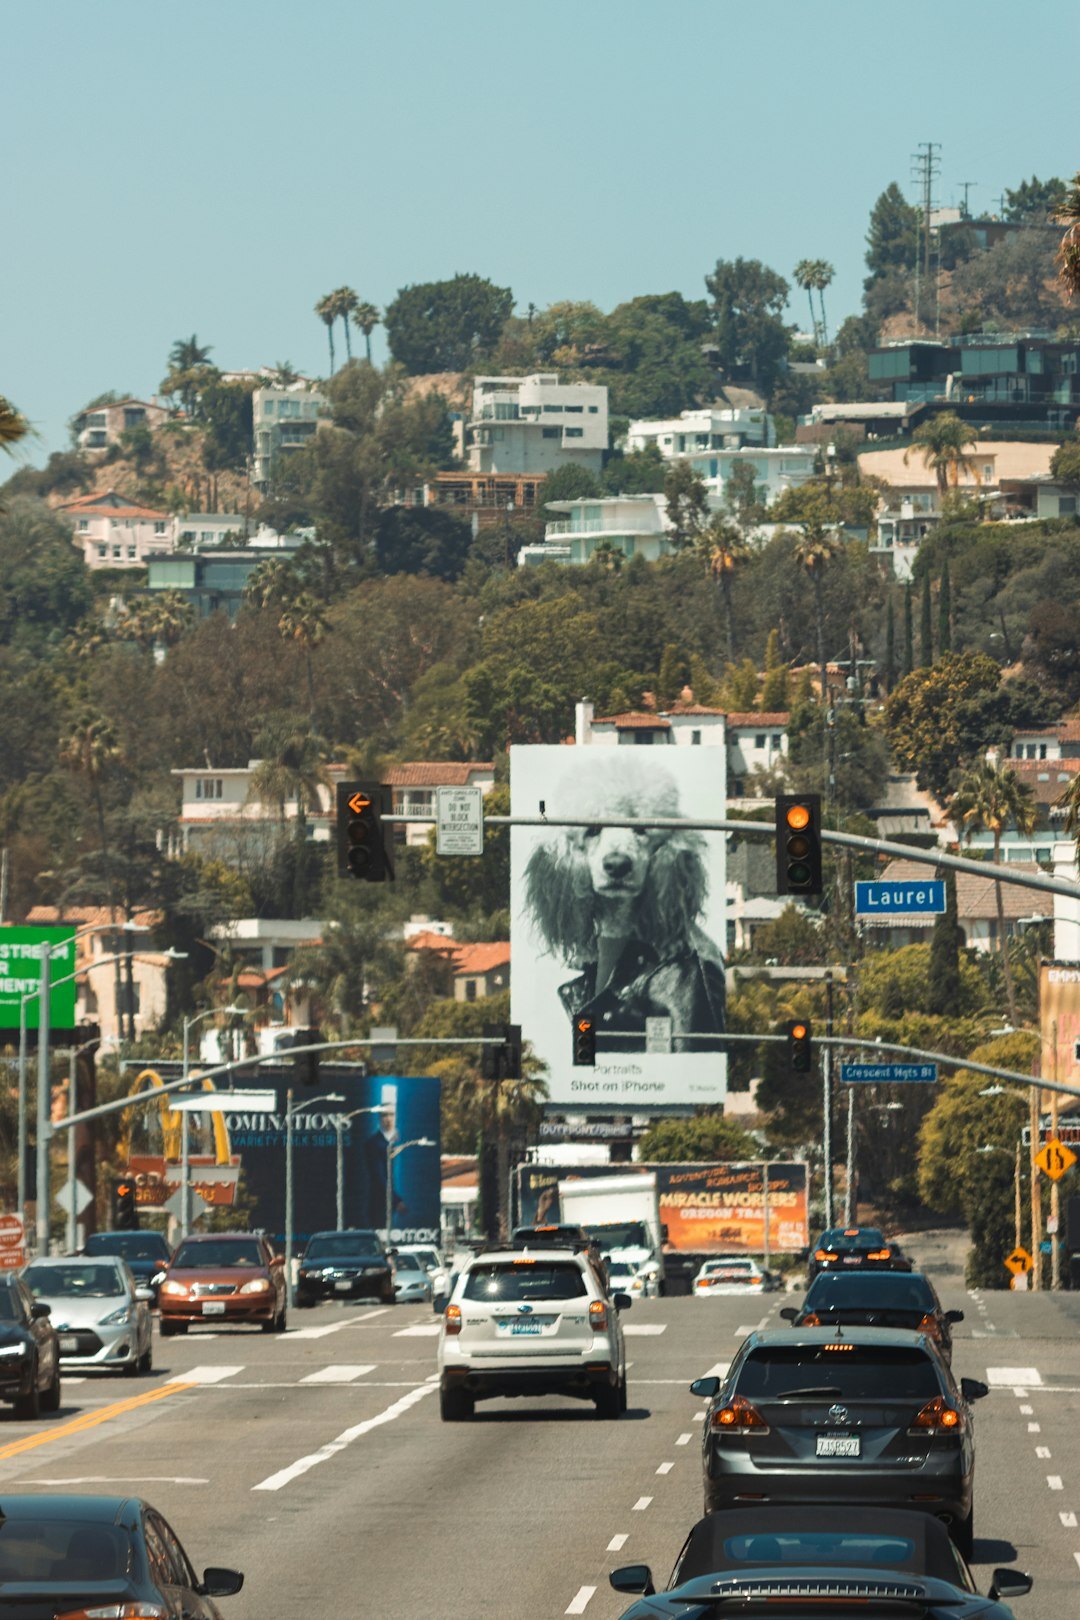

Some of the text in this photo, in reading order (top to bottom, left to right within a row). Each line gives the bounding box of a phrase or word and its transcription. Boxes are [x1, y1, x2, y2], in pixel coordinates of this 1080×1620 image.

[448, 803, 471, 811] DO NOT
[451, 813, 468, 821] BLOCK
[441, 823, 479, 831] INTERSECTION
[868, 888, 934, 905] Laurel
[0, 943, 69, 959] STREM
[593, 1064, 642, 1075] Portraits
[846, 1067, 890, 1077] Crescent
[571, 1080, 665, 1091] Shot on iPhone
[226, 1112, 352, 1131] OMINATIONS
[283, 1134, 307, 1147] TLK
[312, 1134, 351, 1147] SERIS
[660, 1192, 797, 1207] MIRACLE WORKERS
[680, 1208, 777, 1219] OREGON TRAL
